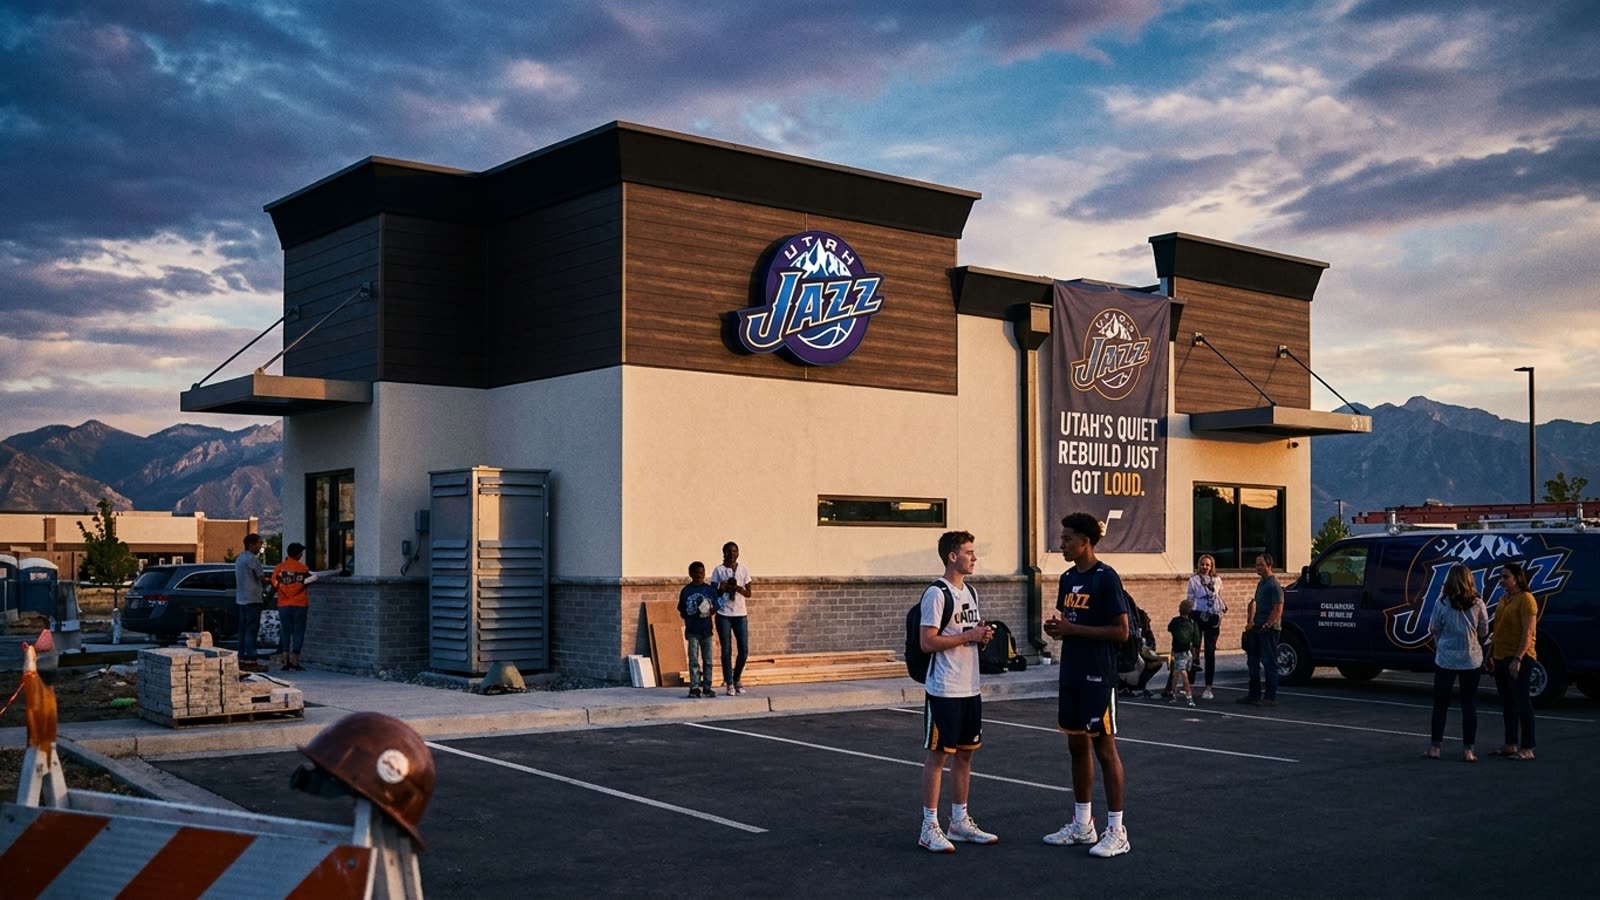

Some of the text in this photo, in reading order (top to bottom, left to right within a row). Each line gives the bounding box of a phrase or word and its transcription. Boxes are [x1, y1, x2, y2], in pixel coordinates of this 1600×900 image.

[746, 271, 882, 348] JAZZ
[1074, 336, 1149, 388] JAZZ
[1060, 411, 1158, 442] UTAH'S QUIET
[1058, 440, 1159, 469] REBUILD JUST
[1071, 469, 1145, 496] GOT LOUD.
[1393, 553, 1564, 644] JZZ
